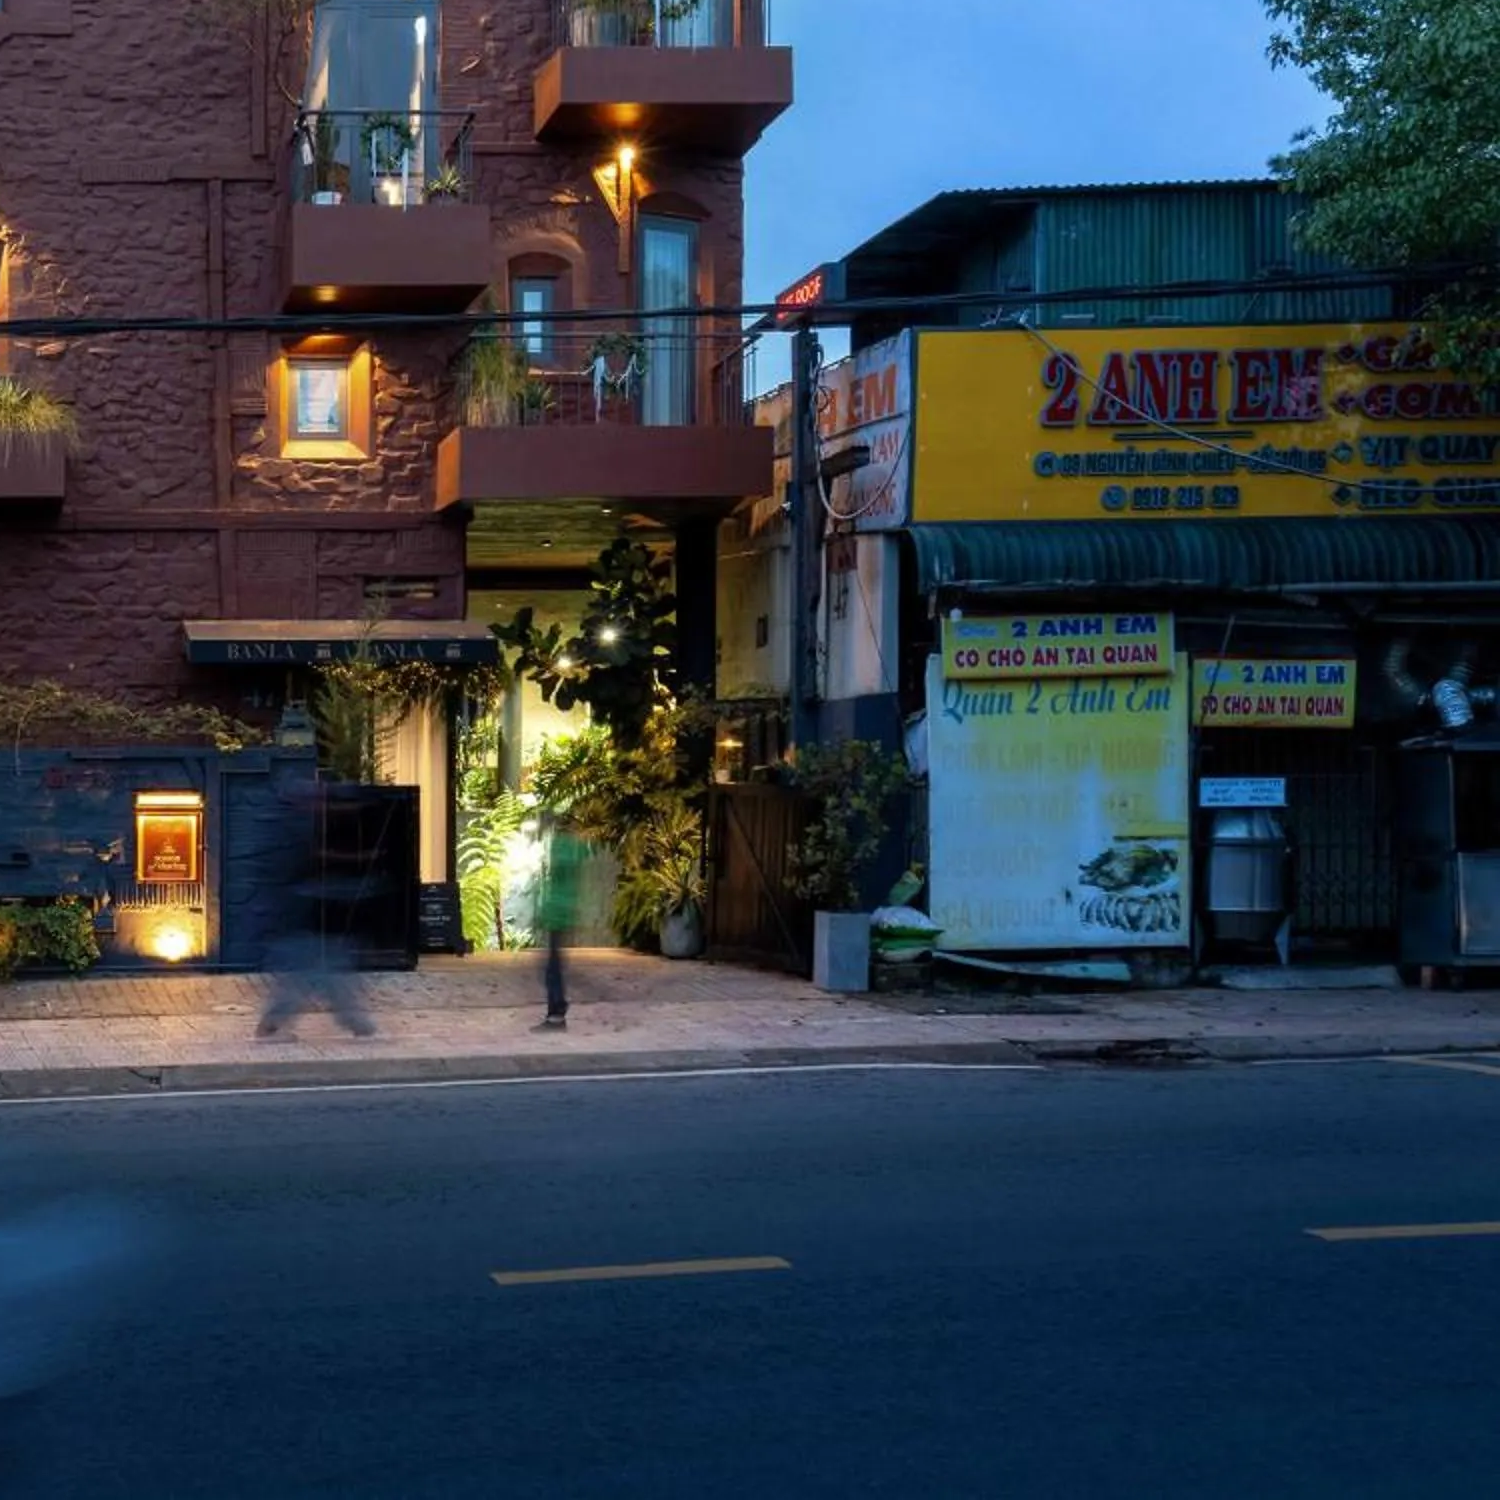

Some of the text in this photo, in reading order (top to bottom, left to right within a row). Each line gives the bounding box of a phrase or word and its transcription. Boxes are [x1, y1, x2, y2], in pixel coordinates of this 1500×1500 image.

[847, 364, 896, 427] EM
[1042, 346, 1326, 426] 2 ANH EM
[1418, 435, 1500, 464] QUAY
[1433, 477, 1500, 507] QUA
[1011, 621, 1029, 639] 2
[1038, 618, 1102, 638] ANH
[1115, 616, 1156, 635] EM
[227, 643, 296, 660] BANLA
[1243, 665, 1255, 684] 2
[1262, 665, 1307, 684] ANH
[1315, 665, 1345, 684] EM
